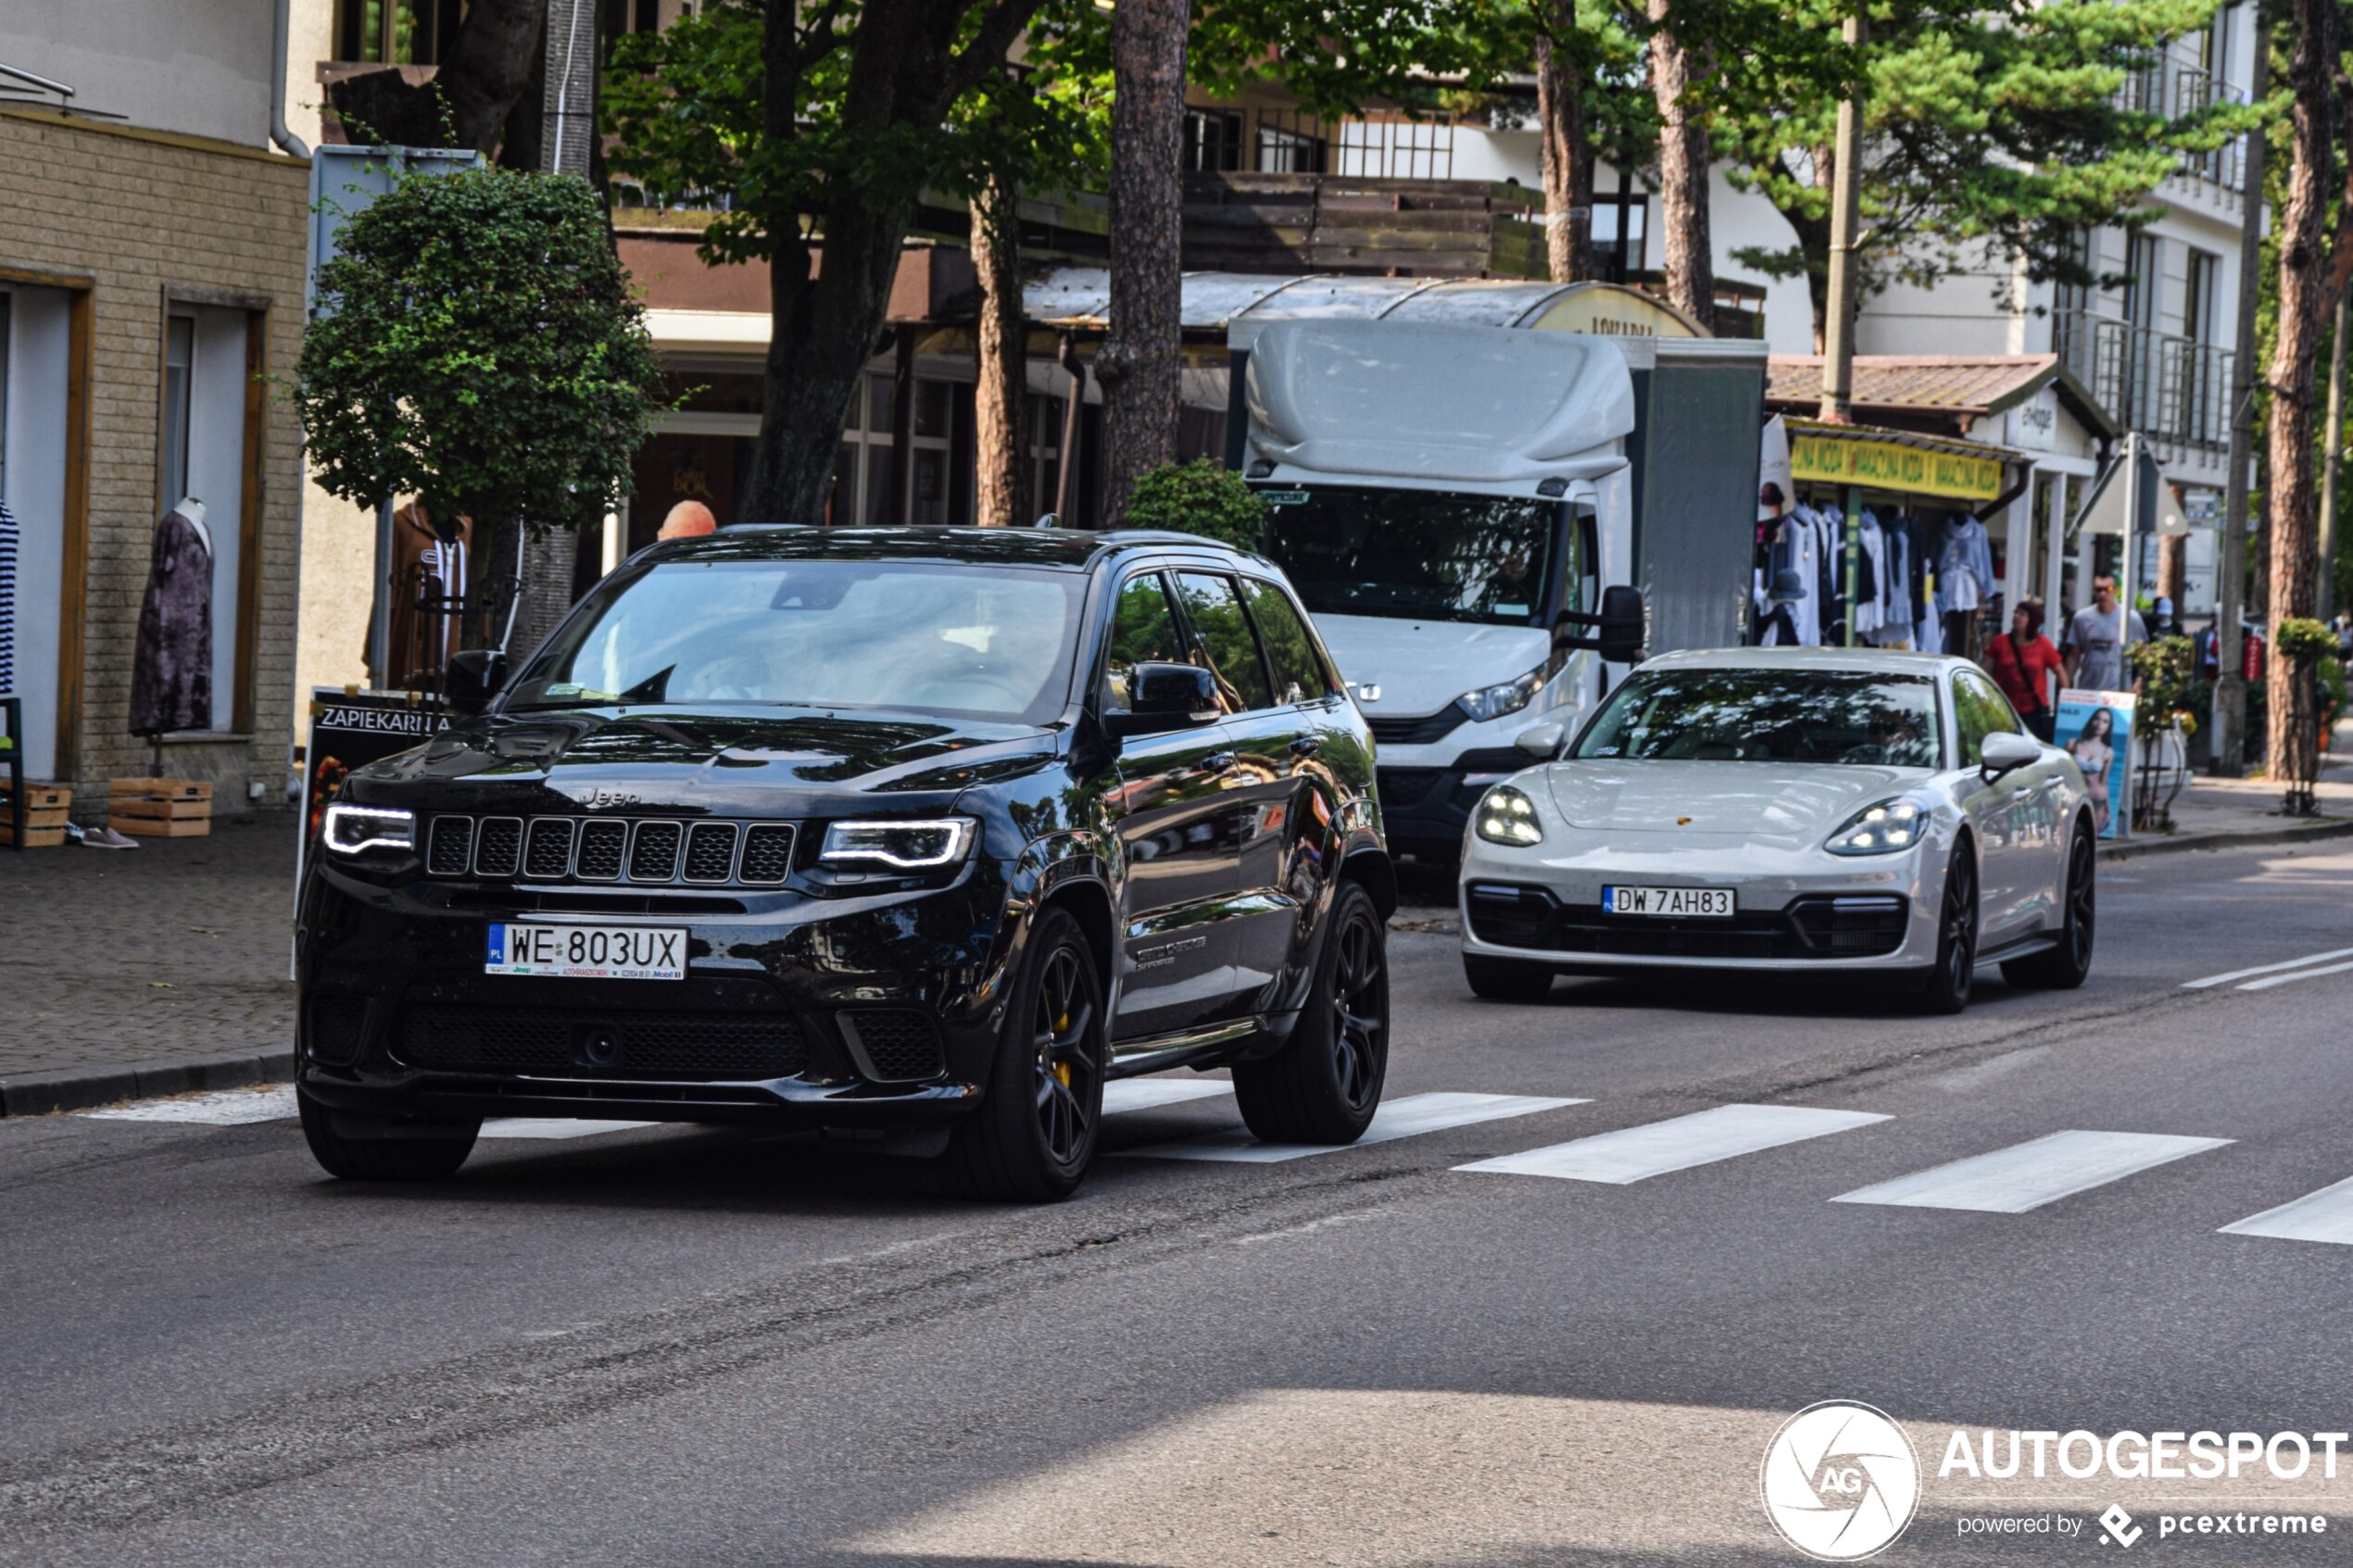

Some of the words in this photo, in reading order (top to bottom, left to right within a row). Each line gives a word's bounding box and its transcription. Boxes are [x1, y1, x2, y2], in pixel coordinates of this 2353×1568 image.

[579, 787, 642, 807] Jeep
[1617, 889, 1647, 911] DW
[1656, 890, 1728, 914] 7AH83
[491, 950, 502, 960] PL
[512, 928, 554, 963] WE
[568, 930, 678, 968] 803UX
[512, 966, 532, 974] Jeep
